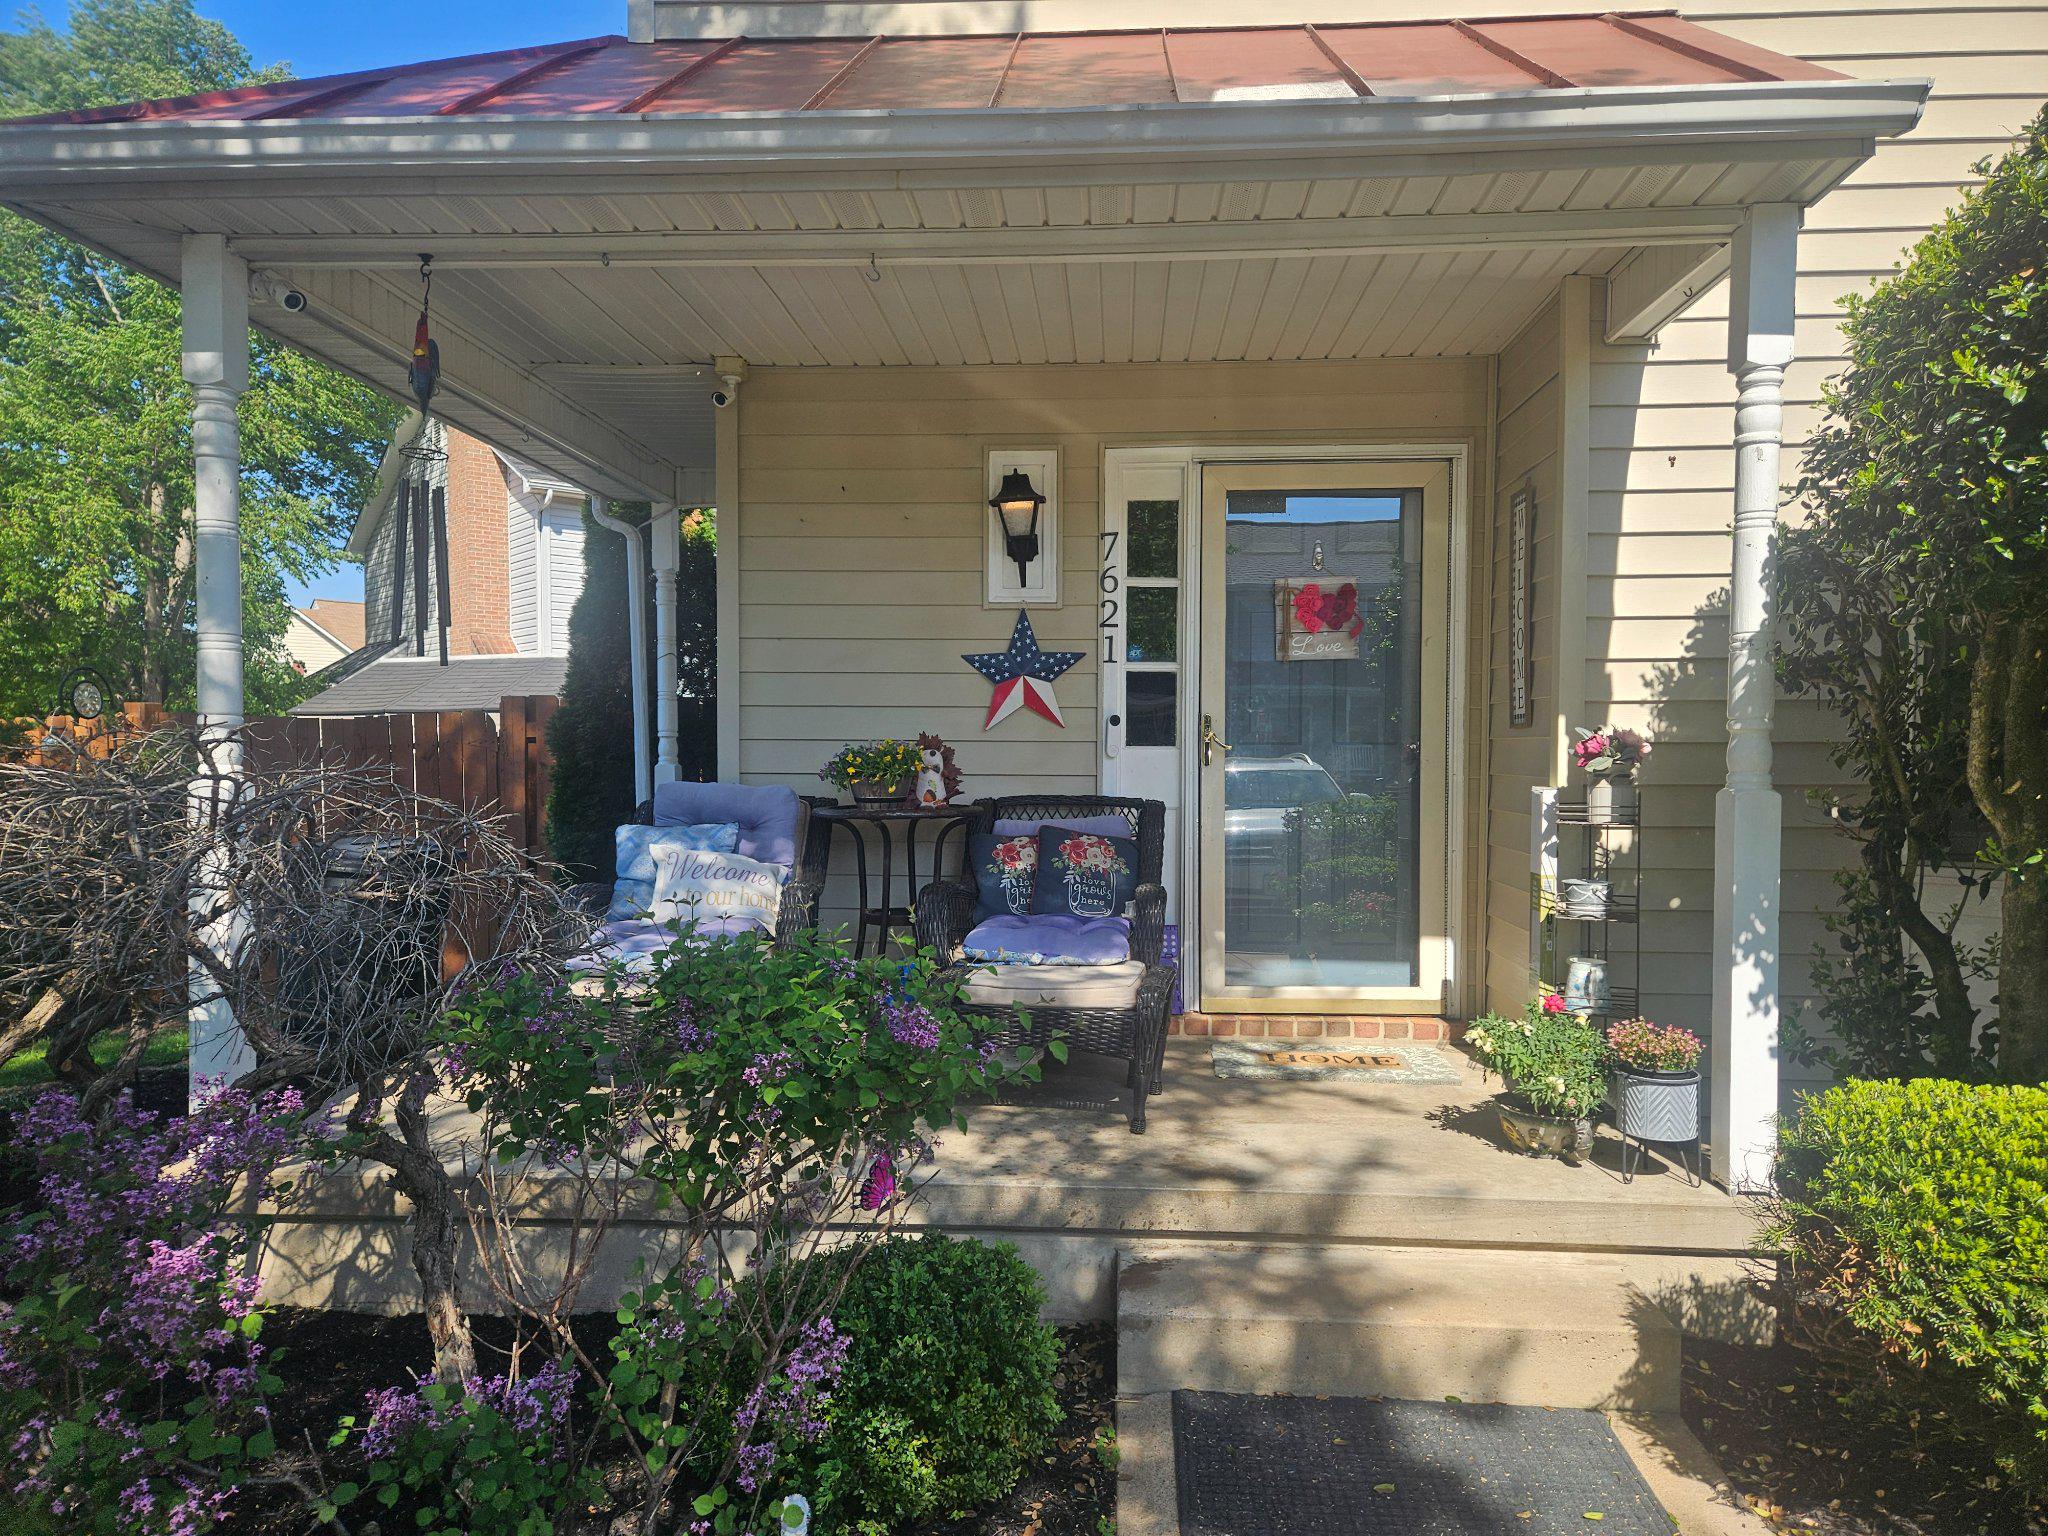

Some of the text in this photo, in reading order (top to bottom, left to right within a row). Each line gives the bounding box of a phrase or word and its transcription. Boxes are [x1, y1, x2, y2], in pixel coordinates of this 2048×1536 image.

[1100, 532, 1118, 663] 7621
[1516, 508, 1525, 710] WELCOME
[1291, 635, 1343, 656] Love
[666, 851, 771, 887] Welcome
[1019, 878, 1034, 887] lo
[1083, 876, 1106, 886] love
[706, 889, 736, 906] our
[1070, 884, 1112, 906] grows
[1081, 896, 1105, 905] here
[1265, 1053, 1400, 1066] HOME
